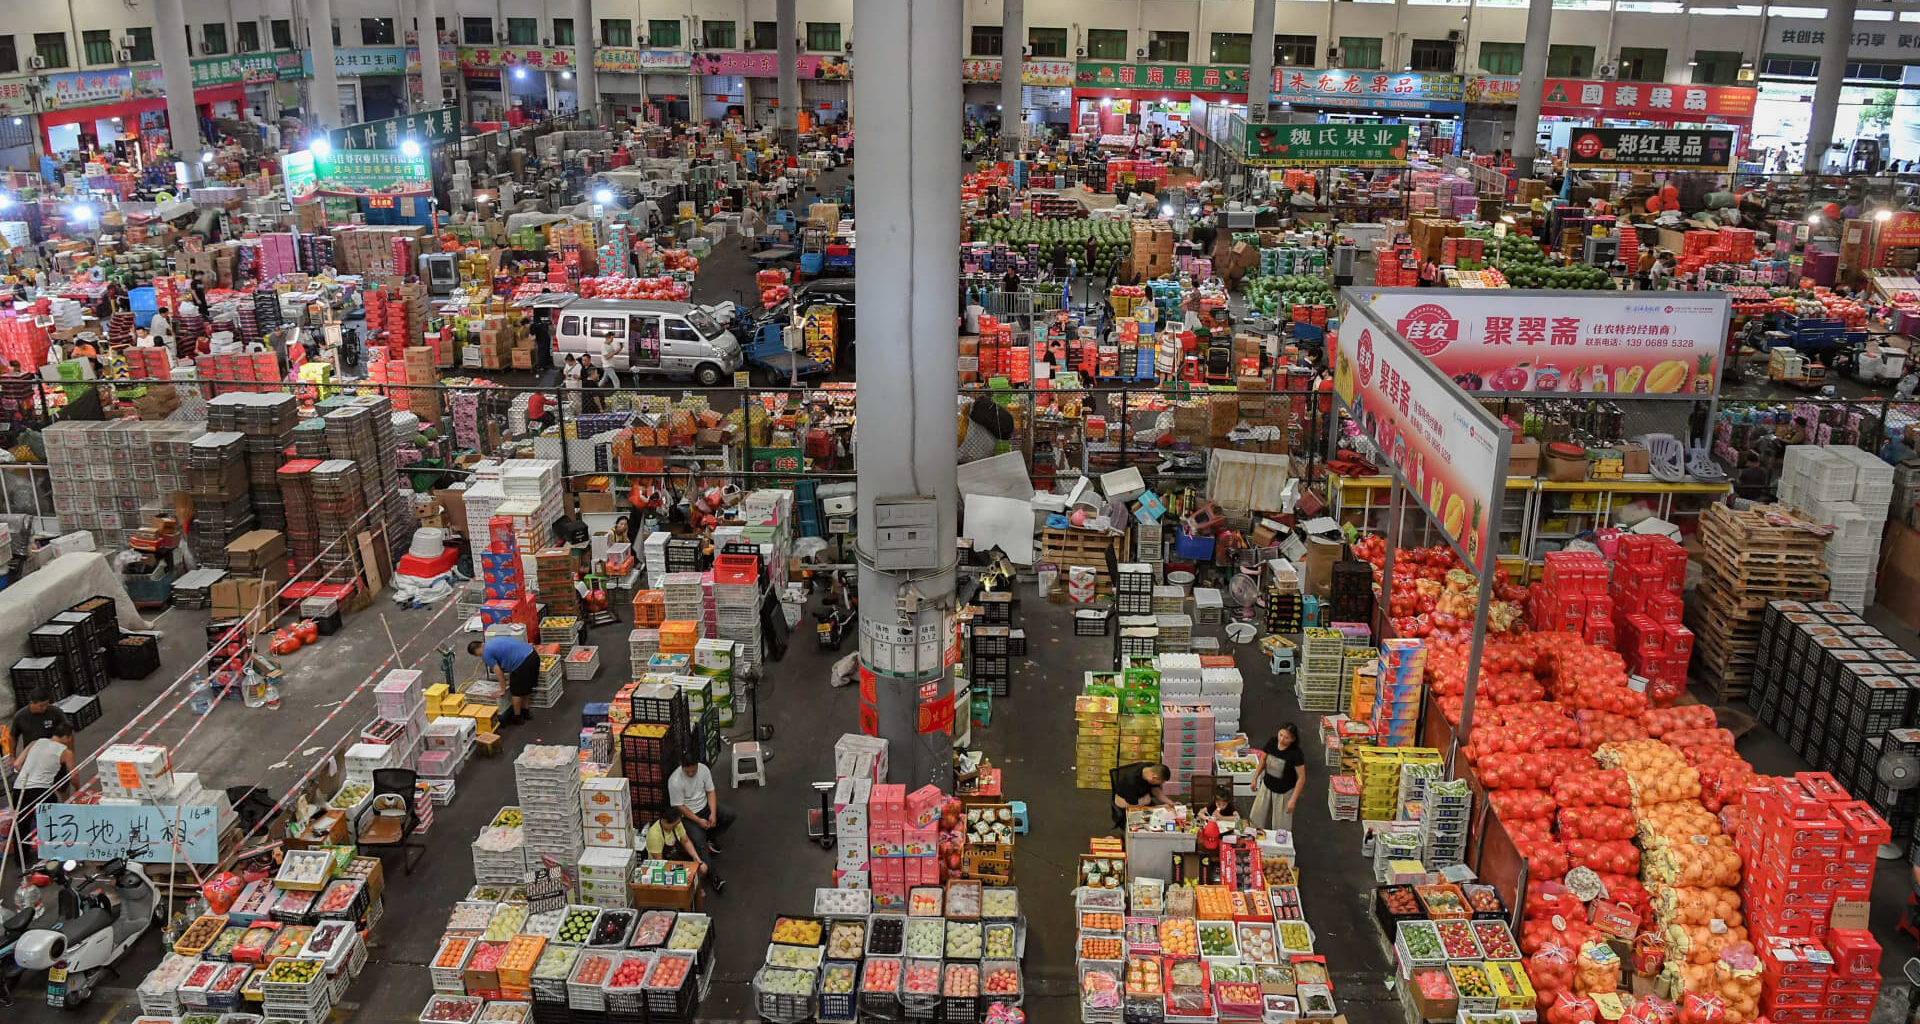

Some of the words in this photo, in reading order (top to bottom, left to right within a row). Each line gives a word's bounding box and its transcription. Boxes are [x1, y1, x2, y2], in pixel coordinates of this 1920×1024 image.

[334, 54, 397, 66] 公共卫生间
[475, 49, 569, 66] 开心果业
[1119, 66, 1221, 86] 新海果品
[1581, 84, 1707, 111] 國泰果品
[343, 110, 453, 151] 小叶精品水果
[1290, 128, 1393, 146] 魏氏果业
[1617, 134, 1702, 156] 郑红果品
[1406, 320, 1449, 340] 佳农
[1483, 316, 1581, 346] 聚翠斋
[1626, 338, 1642, 347] 139
[1645, 338, 1668, 347] 0689
[1671, 339, 1694, 348] 5328
[190, 805, 212, 818] 16#
[45, 814, 194, 850] 场地出租
